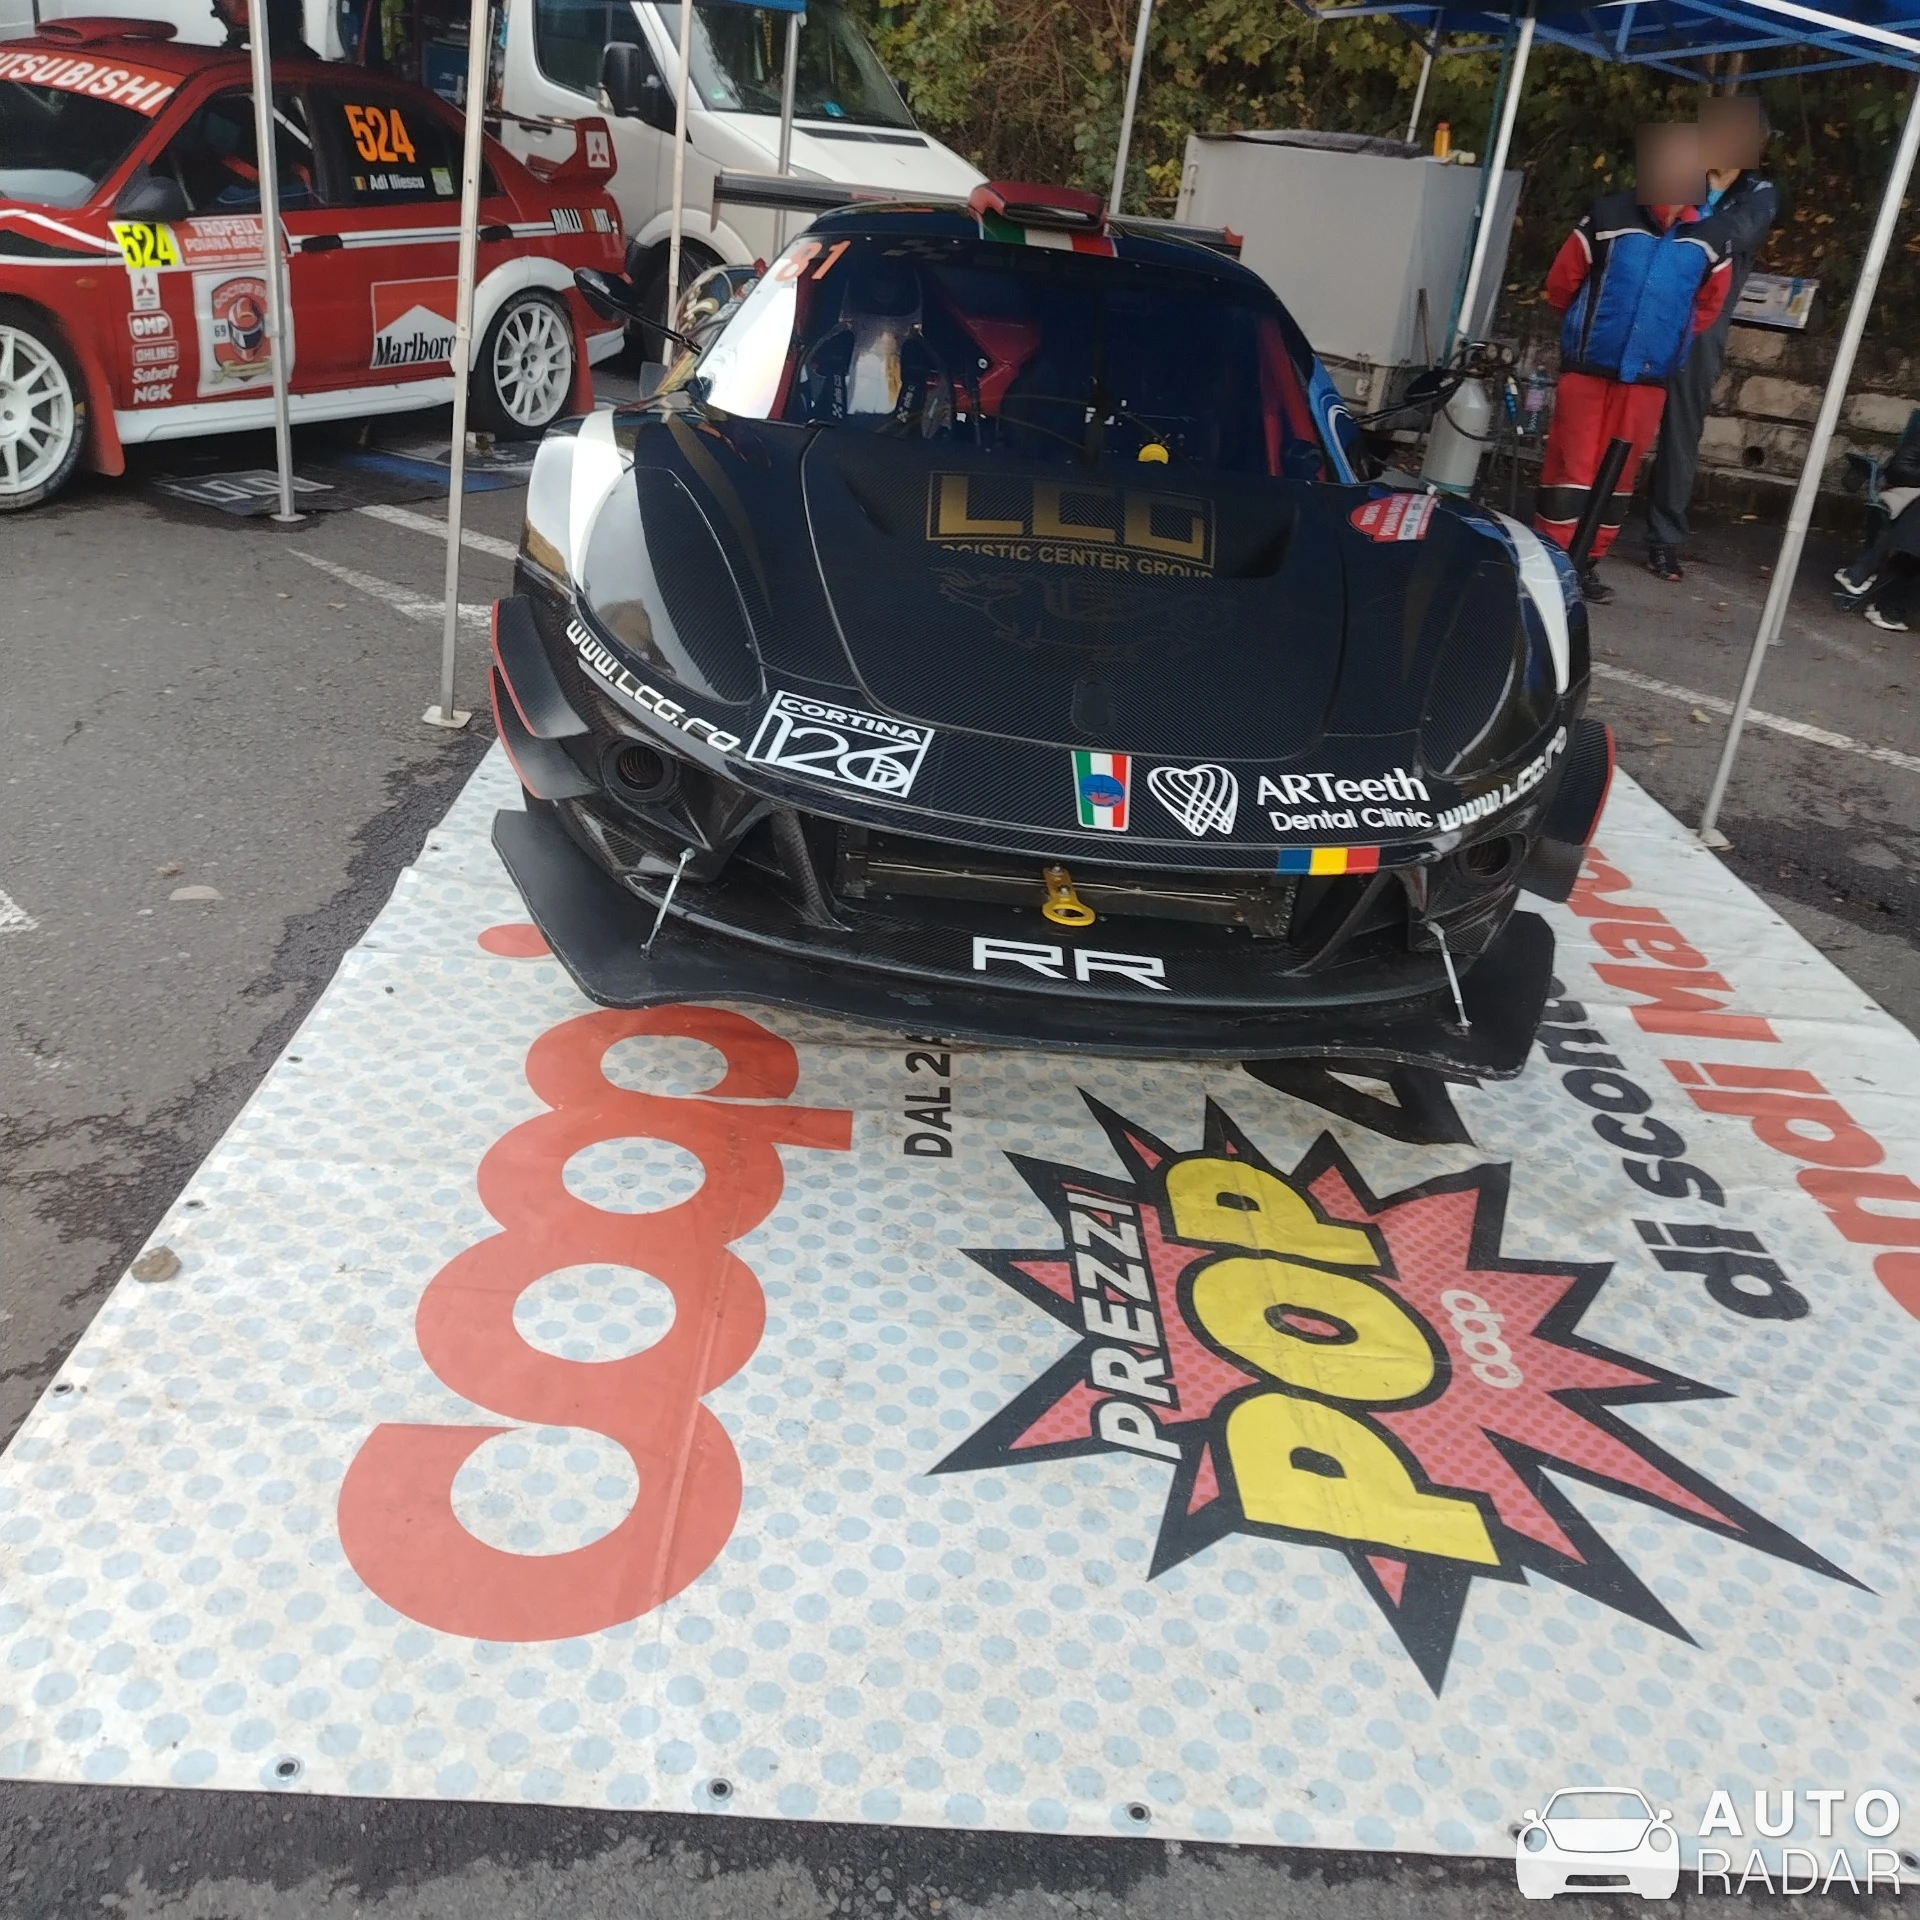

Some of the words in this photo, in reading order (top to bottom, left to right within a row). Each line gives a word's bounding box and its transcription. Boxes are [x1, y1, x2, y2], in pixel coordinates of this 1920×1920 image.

[0, 52, 175, 111] ITSUBISHI
[344, 104, 416, 163] 524
[113, 223, 178, 269] 524
[189, 219, 263, 237] TROFEUL
[775, 240, 852, 282] 81
[131, 316, 169, 336] OMP
[214, 325, 227, 338] 69
[373, 332, 458, 367] Marlboro
[133, 383, 173, 404] NGK
[1038, 546, 1130, 572] CENTER
[780, 698, 922, 743] CORTINA
[765, 711, 923, 789] 126
[1257, 767, 1430, 805] ARTeeth
[1269, 808, 1359, 832] Dental
[1361, 806, 1433, 830] Clinic
[972, 936, 1172, 991] RR
[1565, 846, 1783, 1043] Marc
[903, 1086, 953, 1159] DAL
[1630, 1218, 1811, 1322] di
[337, 1003, 853, 1643] coop
[1066, 1192, 1182, 1460] PREZZI
[1440, 1289, 1523, 1388] coop
[1165, 1158, 1501, 1566] POP
